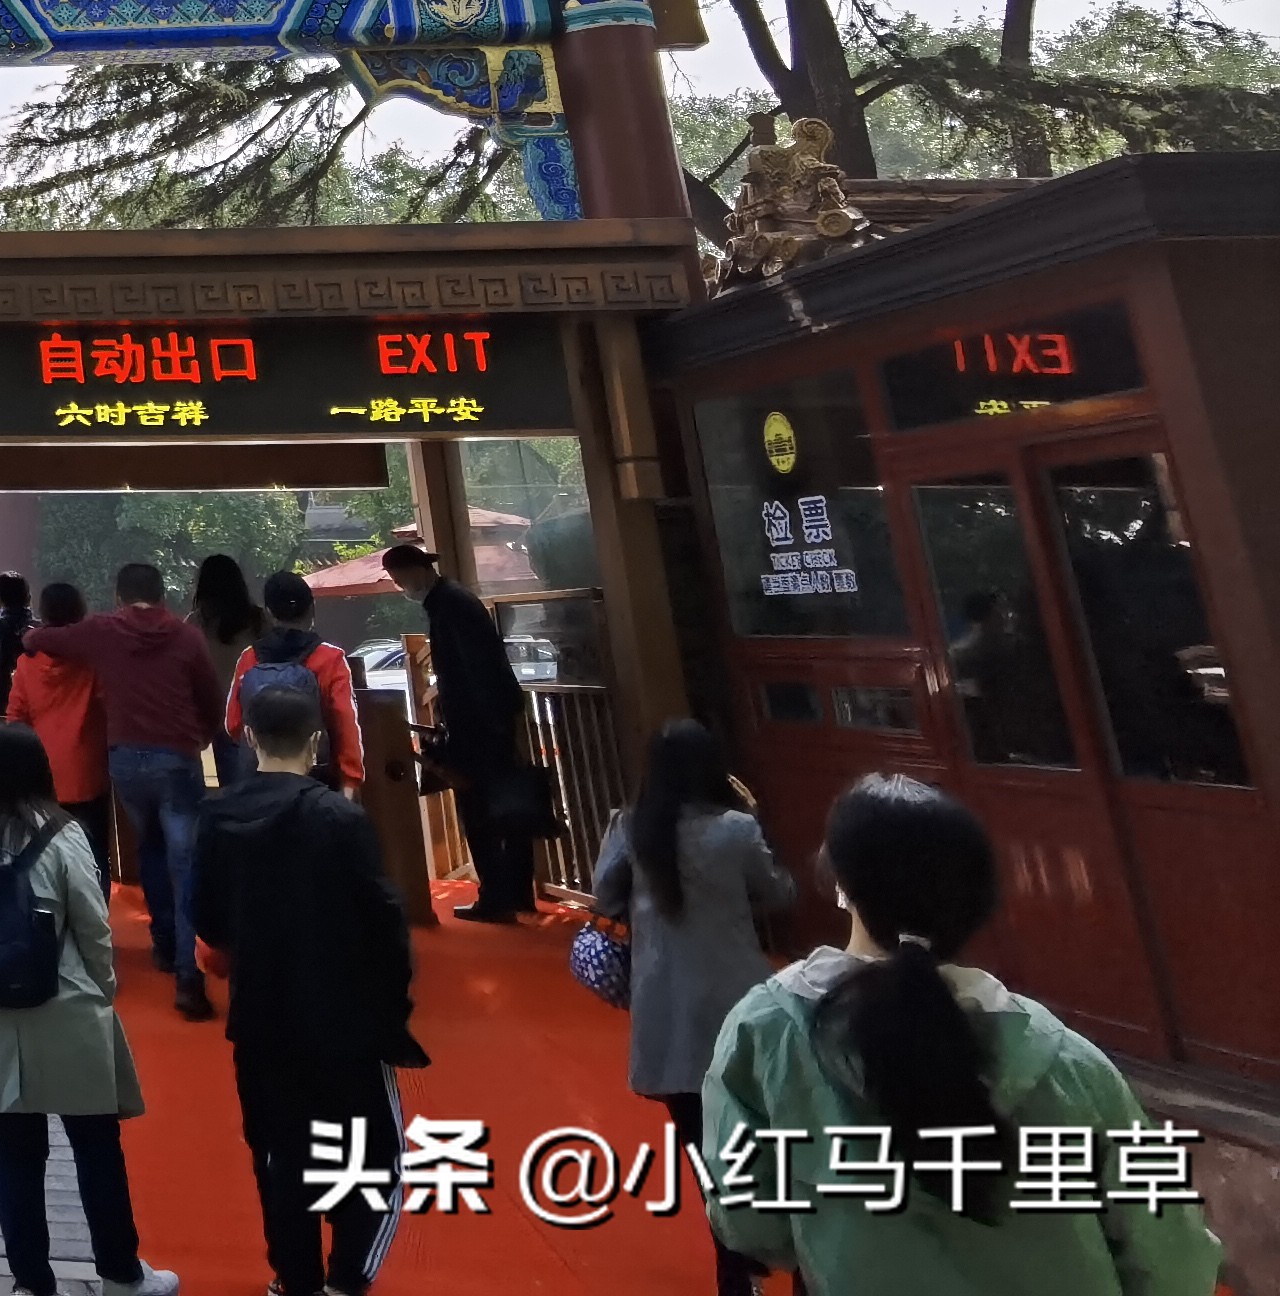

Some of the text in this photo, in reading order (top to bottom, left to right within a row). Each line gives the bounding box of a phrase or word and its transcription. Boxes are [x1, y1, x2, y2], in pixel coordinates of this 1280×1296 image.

[39, 331, 258, 385] 自动出口
[376, 331, 491, 375] EXIT
[54, 396, 485, 428] 六时吉祥 一路平安
